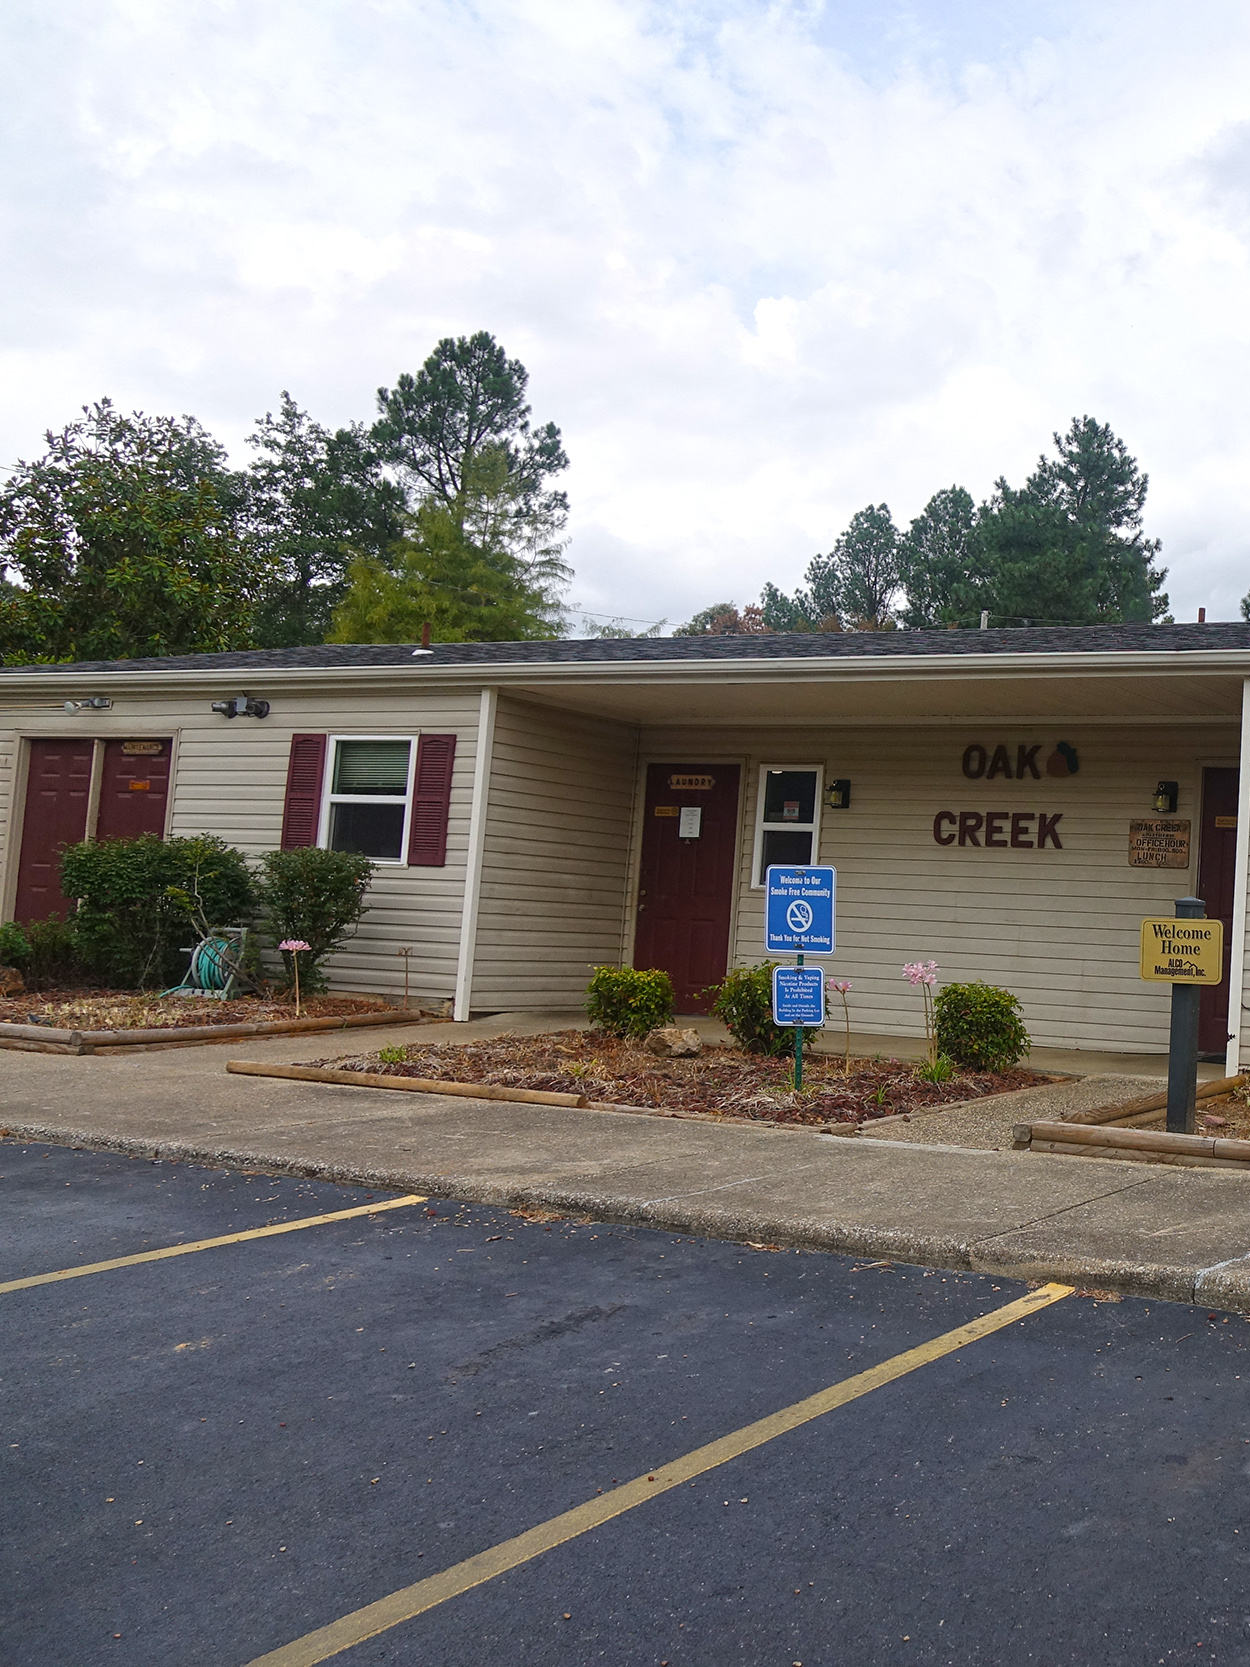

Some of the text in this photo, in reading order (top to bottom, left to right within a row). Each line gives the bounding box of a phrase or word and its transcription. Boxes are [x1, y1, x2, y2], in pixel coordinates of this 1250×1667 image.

[962, 744, 1042, 780] OAK
[670, 778, 712, 786] LAUNDRY
[933, 811, 1064, 849] CREEK
[1137, 823, 1182, 832] OAK CREEK
[1136, 839, 1164, 847] OFFICE
[1137, 852, 1167, 861] LUNCH
[779, 875, 821, 885] Welcome to Our
[770, 887, 830, 898] Smoke Free Community
[1152, 924, 1211, 940] Welcome
[770, 933, 830, 945] Thank You for Not Smoking
[1161, 940, 1201, 955] Home
[1168, 959, 1183, 968] ALCO
[1154, 965, 1206, 977] Management, Inc.
